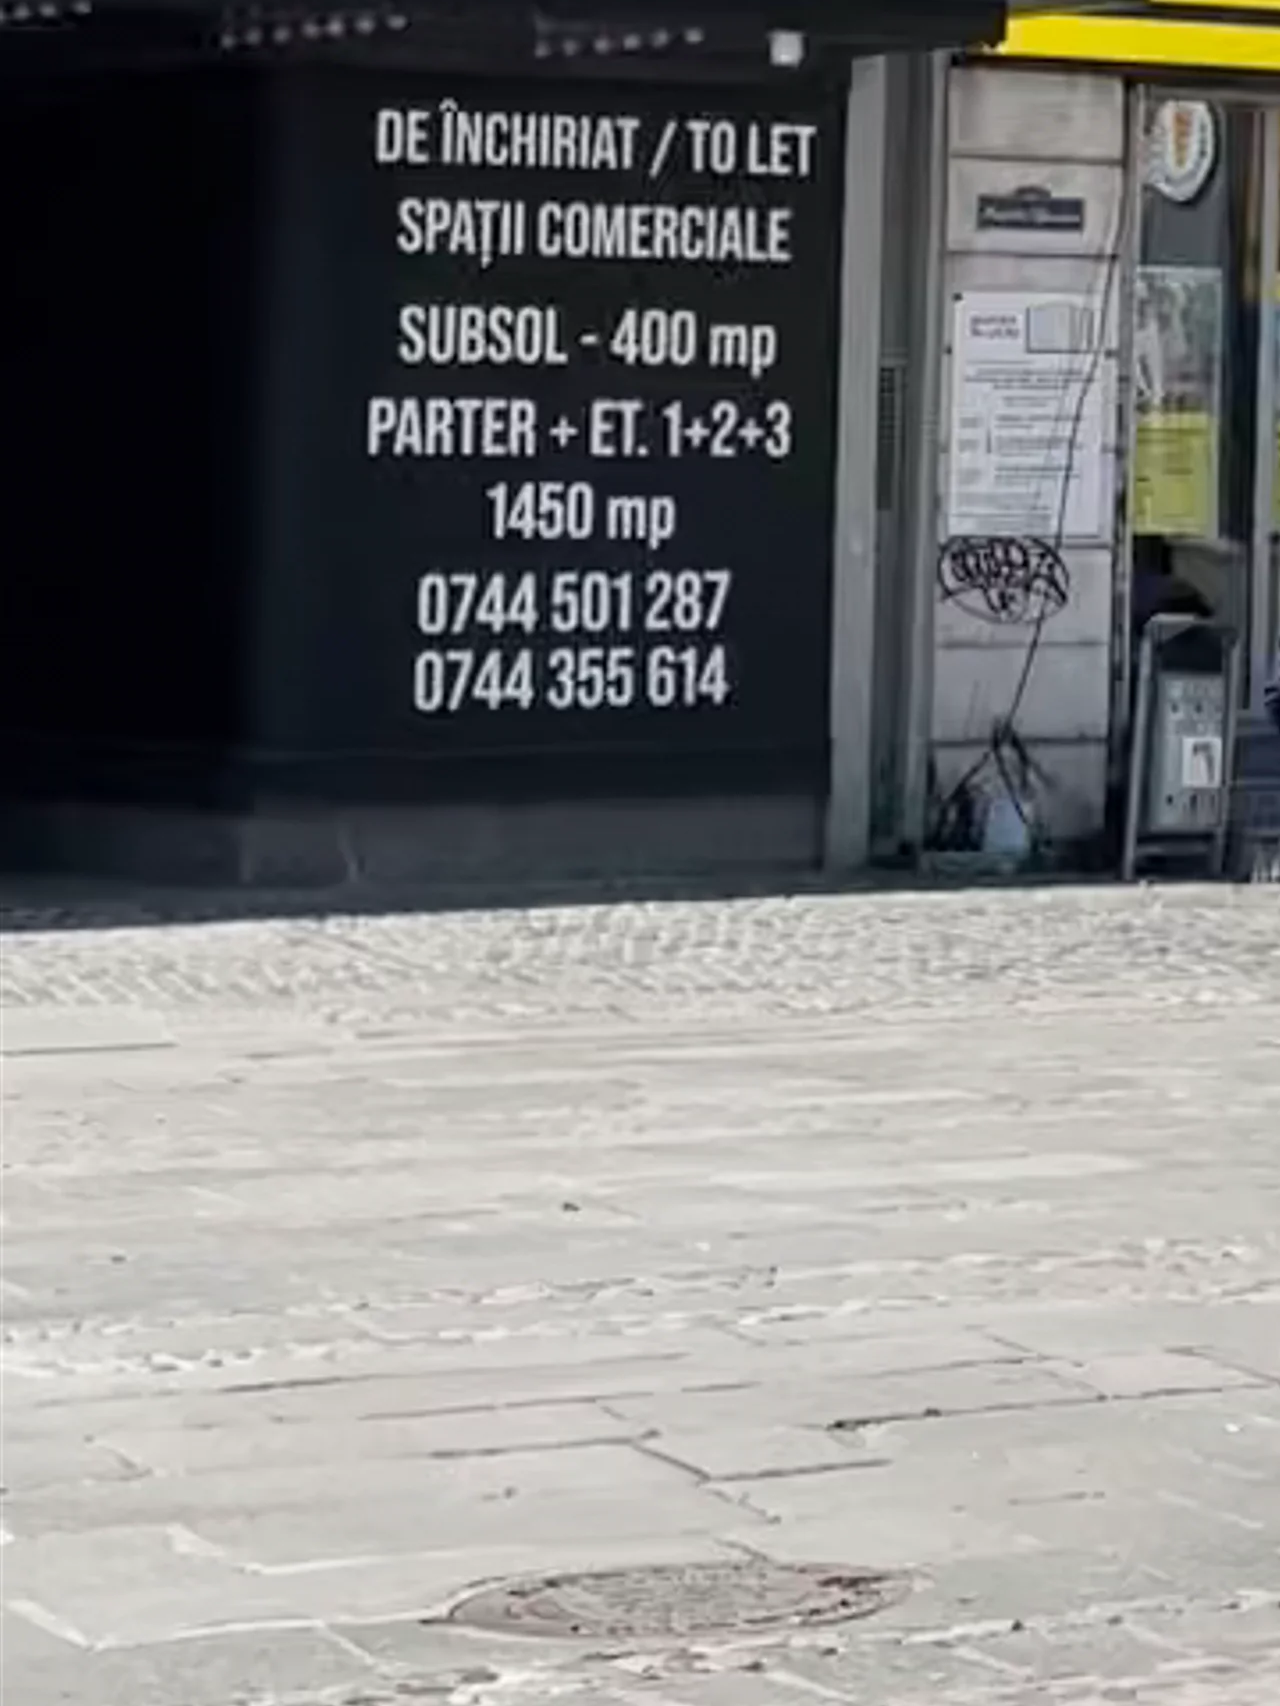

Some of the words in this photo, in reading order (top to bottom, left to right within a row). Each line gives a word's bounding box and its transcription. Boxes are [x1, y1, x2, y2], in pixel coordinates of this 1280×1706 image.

[375, 106, 430, 164] DE
[438, 96, 641, 171] ÎNCHIRIAT
[687, 119, 737, 176] TO
[747, 123, 817, 178] LET
[397, 197, 525, 270] SPAȚII
[536, 200, 793, 263] COMERCIALE
[398, 303, 568, 365] SUBSOL
[610, 307, 697, 367] 400
[708, 322, 778, 378] mp
[366, 397, 537, 458] PARTER
[589, 398, 649, 458] ET.
[662, 399, 793, 459] 1+2+3
[485, 481, 594, 541] 1450
[606, 493, 676, 550] mp
[416, 572, 538, 636] 0744
[551, 570, 631, 633] 501
[644, 569, 732, 632] 287
[412, 648, 535, 712] 0744
[546, 645, 635, 709] 355
[646, 643, 731, 707] 614
